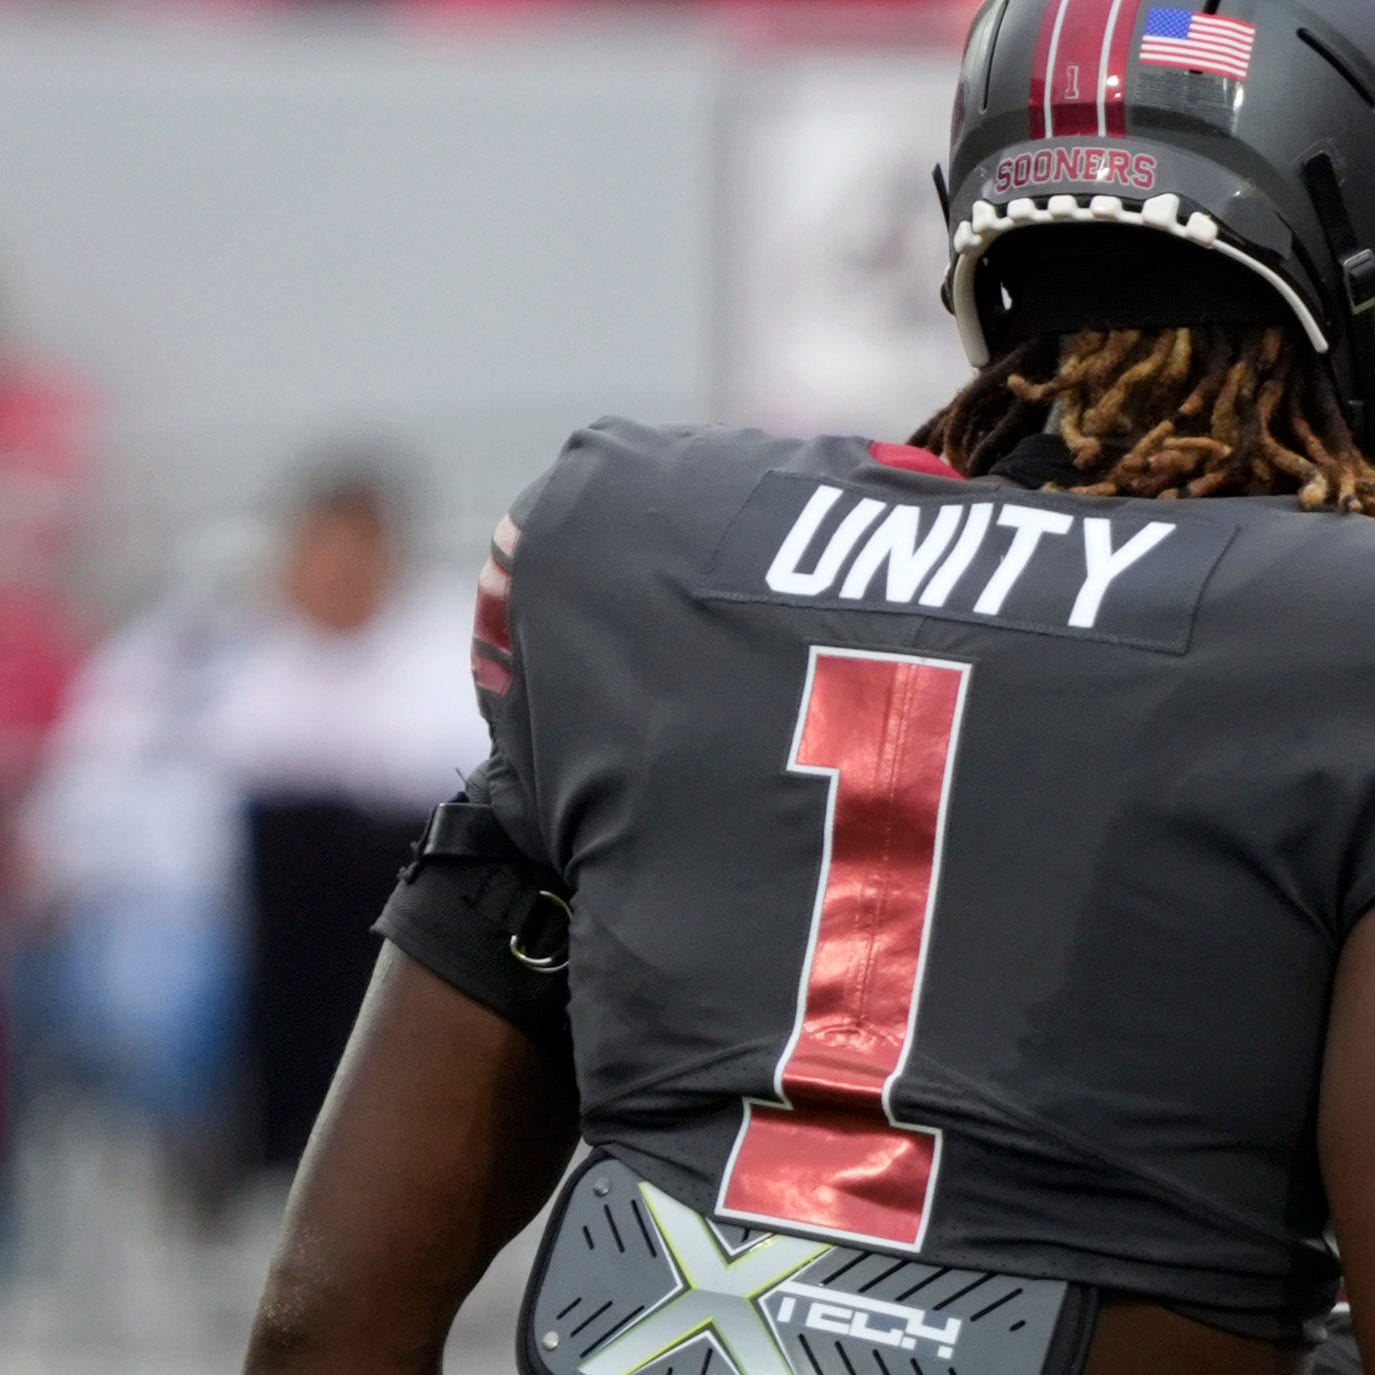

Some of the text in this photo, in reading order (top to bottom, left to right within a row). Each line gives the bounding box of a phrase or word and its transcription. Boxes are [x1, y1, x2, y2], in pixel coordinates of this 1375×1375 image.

[1065, 64, 1080, 100] 1
[994, 146, 1157, 194] SOONERS
[764, 485, 1176, 628] UNITY
[714, 645, 972, 1253] 1
